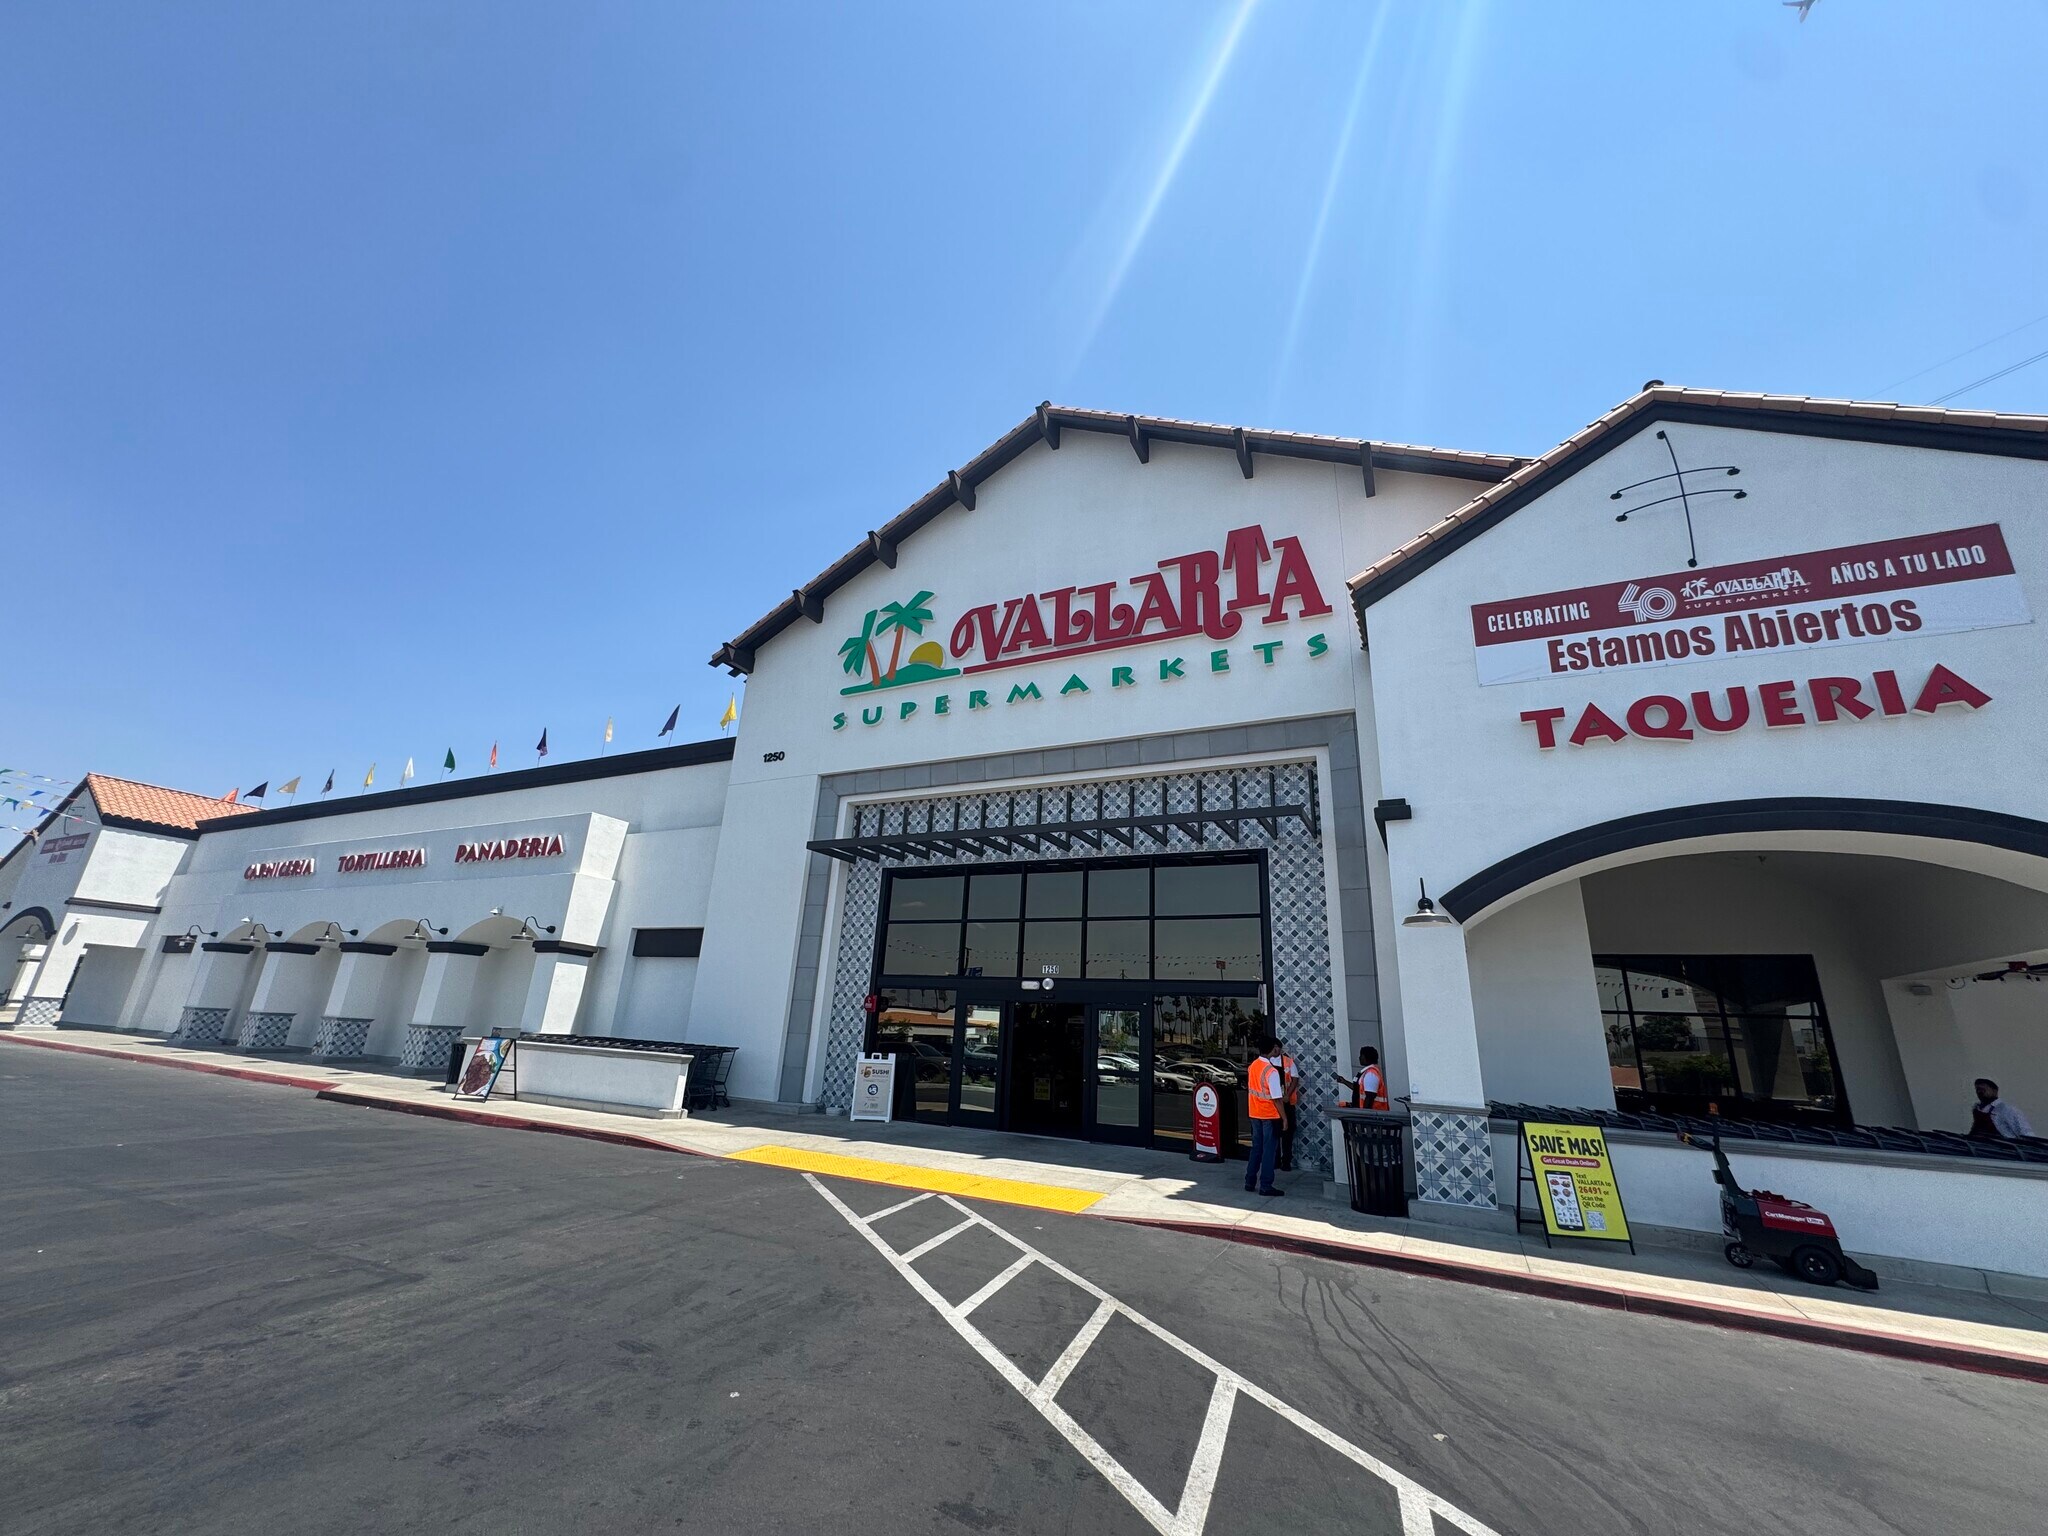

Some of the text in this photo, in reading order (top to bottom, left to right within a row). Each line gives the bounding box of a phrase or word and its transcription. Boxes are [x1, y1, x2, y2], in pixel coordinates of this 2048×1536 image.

[1830, 545, 1987, 585] AÑOS A TU LADO
[949, 524, 1333, 661] VALLARTA
[1714, 567, 1807, 594] VALLARTA
[1487, 582, 1677, 633] CELEBRATING 40
[1685, 588, 1810, 610] SUPERMARKETS
[1547, 599, 1923, 674] Estamos Abiertos
[832, 632, 1330, 731] SUPERMARKETS
[1520, 663, 1994, 750] TAQUERIA
[763, 751, 786, 763] 1250
[338, 848, 425, 873] TORTILLERIA
[455, 834, 564, 863] PANADERIA
[244, 858, 315, 880] CARNICERIA
[1042, 965, 1060, 974] 1250
[1530, 1134, 1605, 1157] SAVE MAS!
[1579, 1186, 1602, 1195] 26491
[1582, 1201, 1591, 1209] QR
[1765, 1211, 1805, 1222] CartManager
